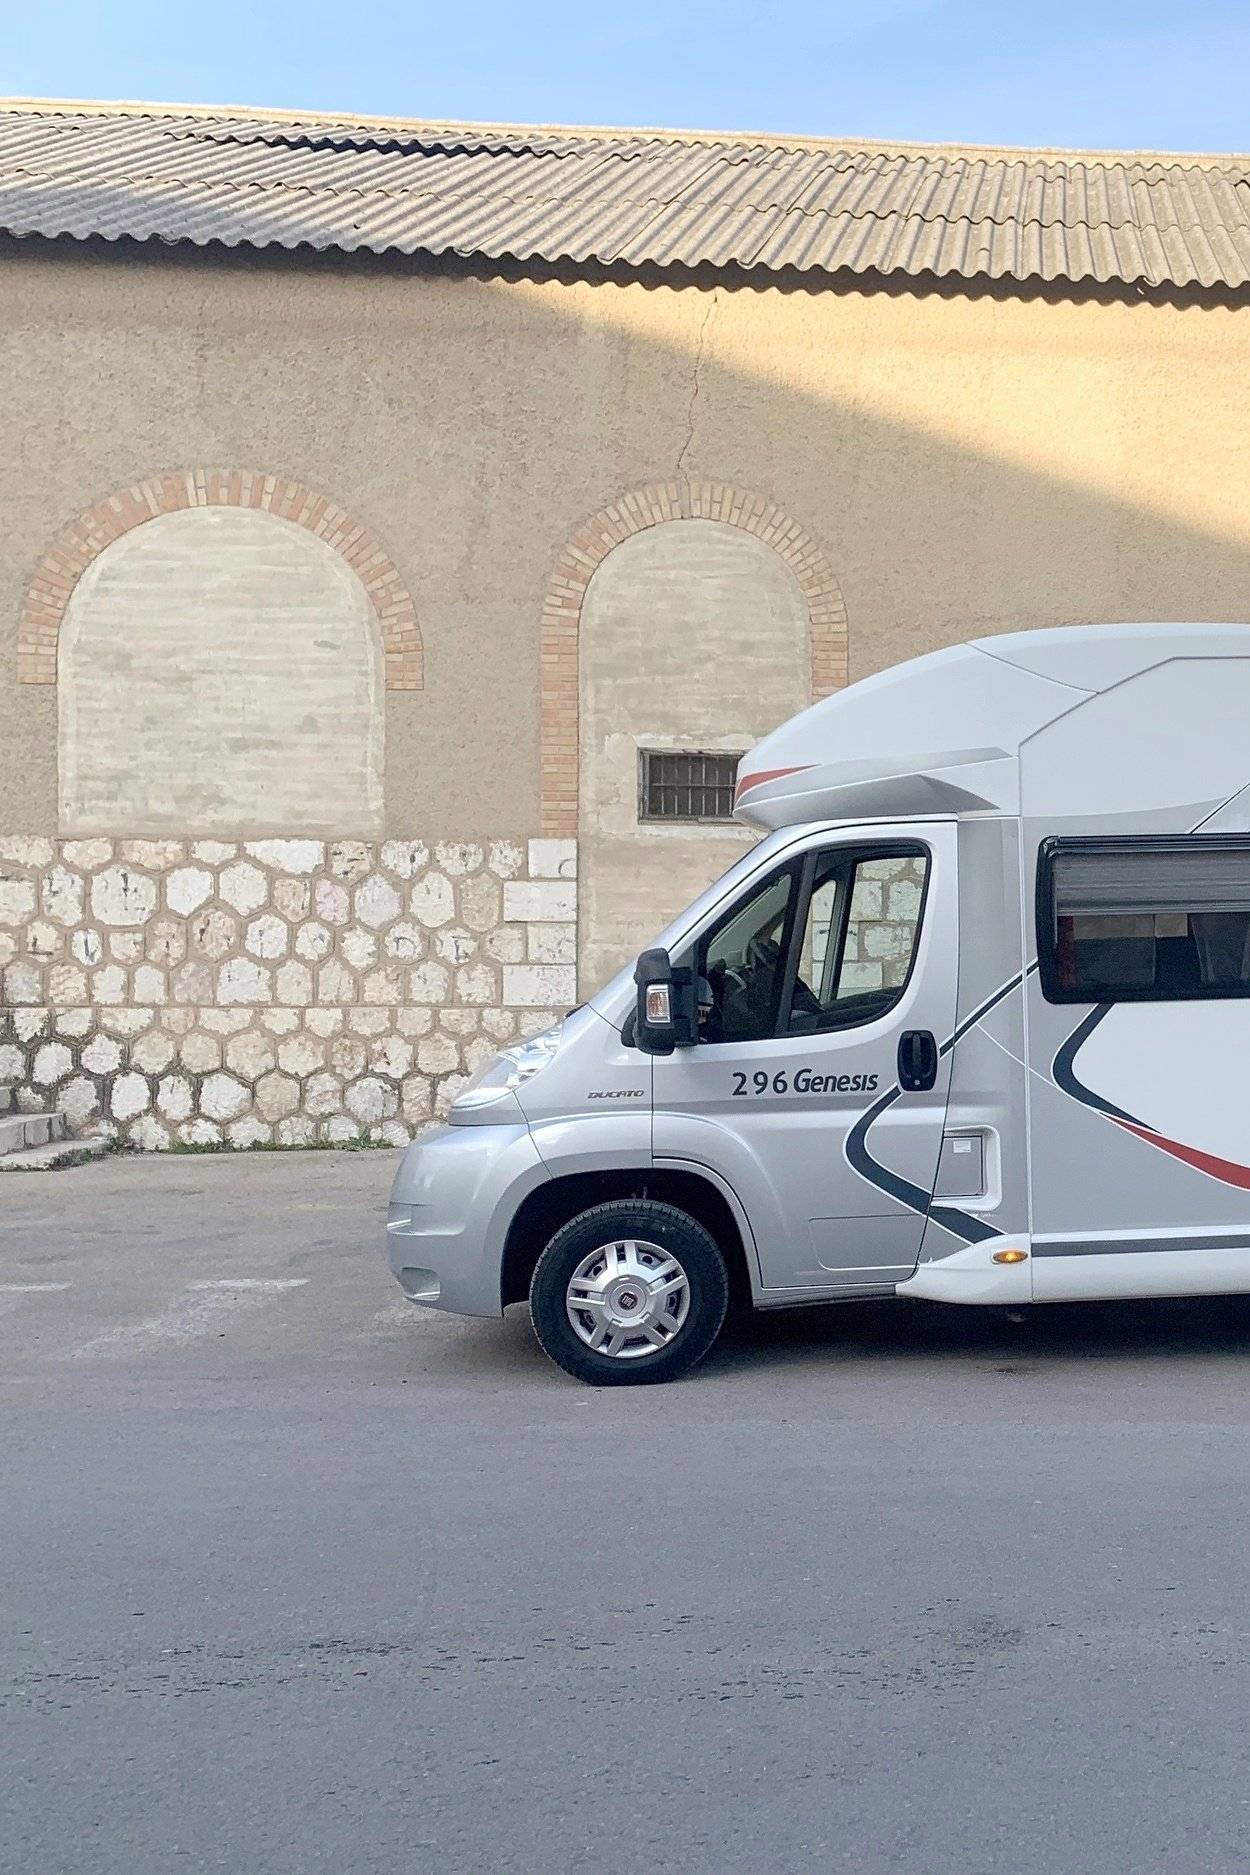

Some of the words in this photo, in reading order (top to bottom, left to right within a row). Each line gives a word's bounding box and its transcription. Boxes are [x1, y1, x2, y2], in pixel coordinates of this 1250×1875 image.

[732, 1070, 788, 1096] 296
[793, 1068, 879, 1093] Genesis
[587, 1089, 645, 1099] DUCATO
